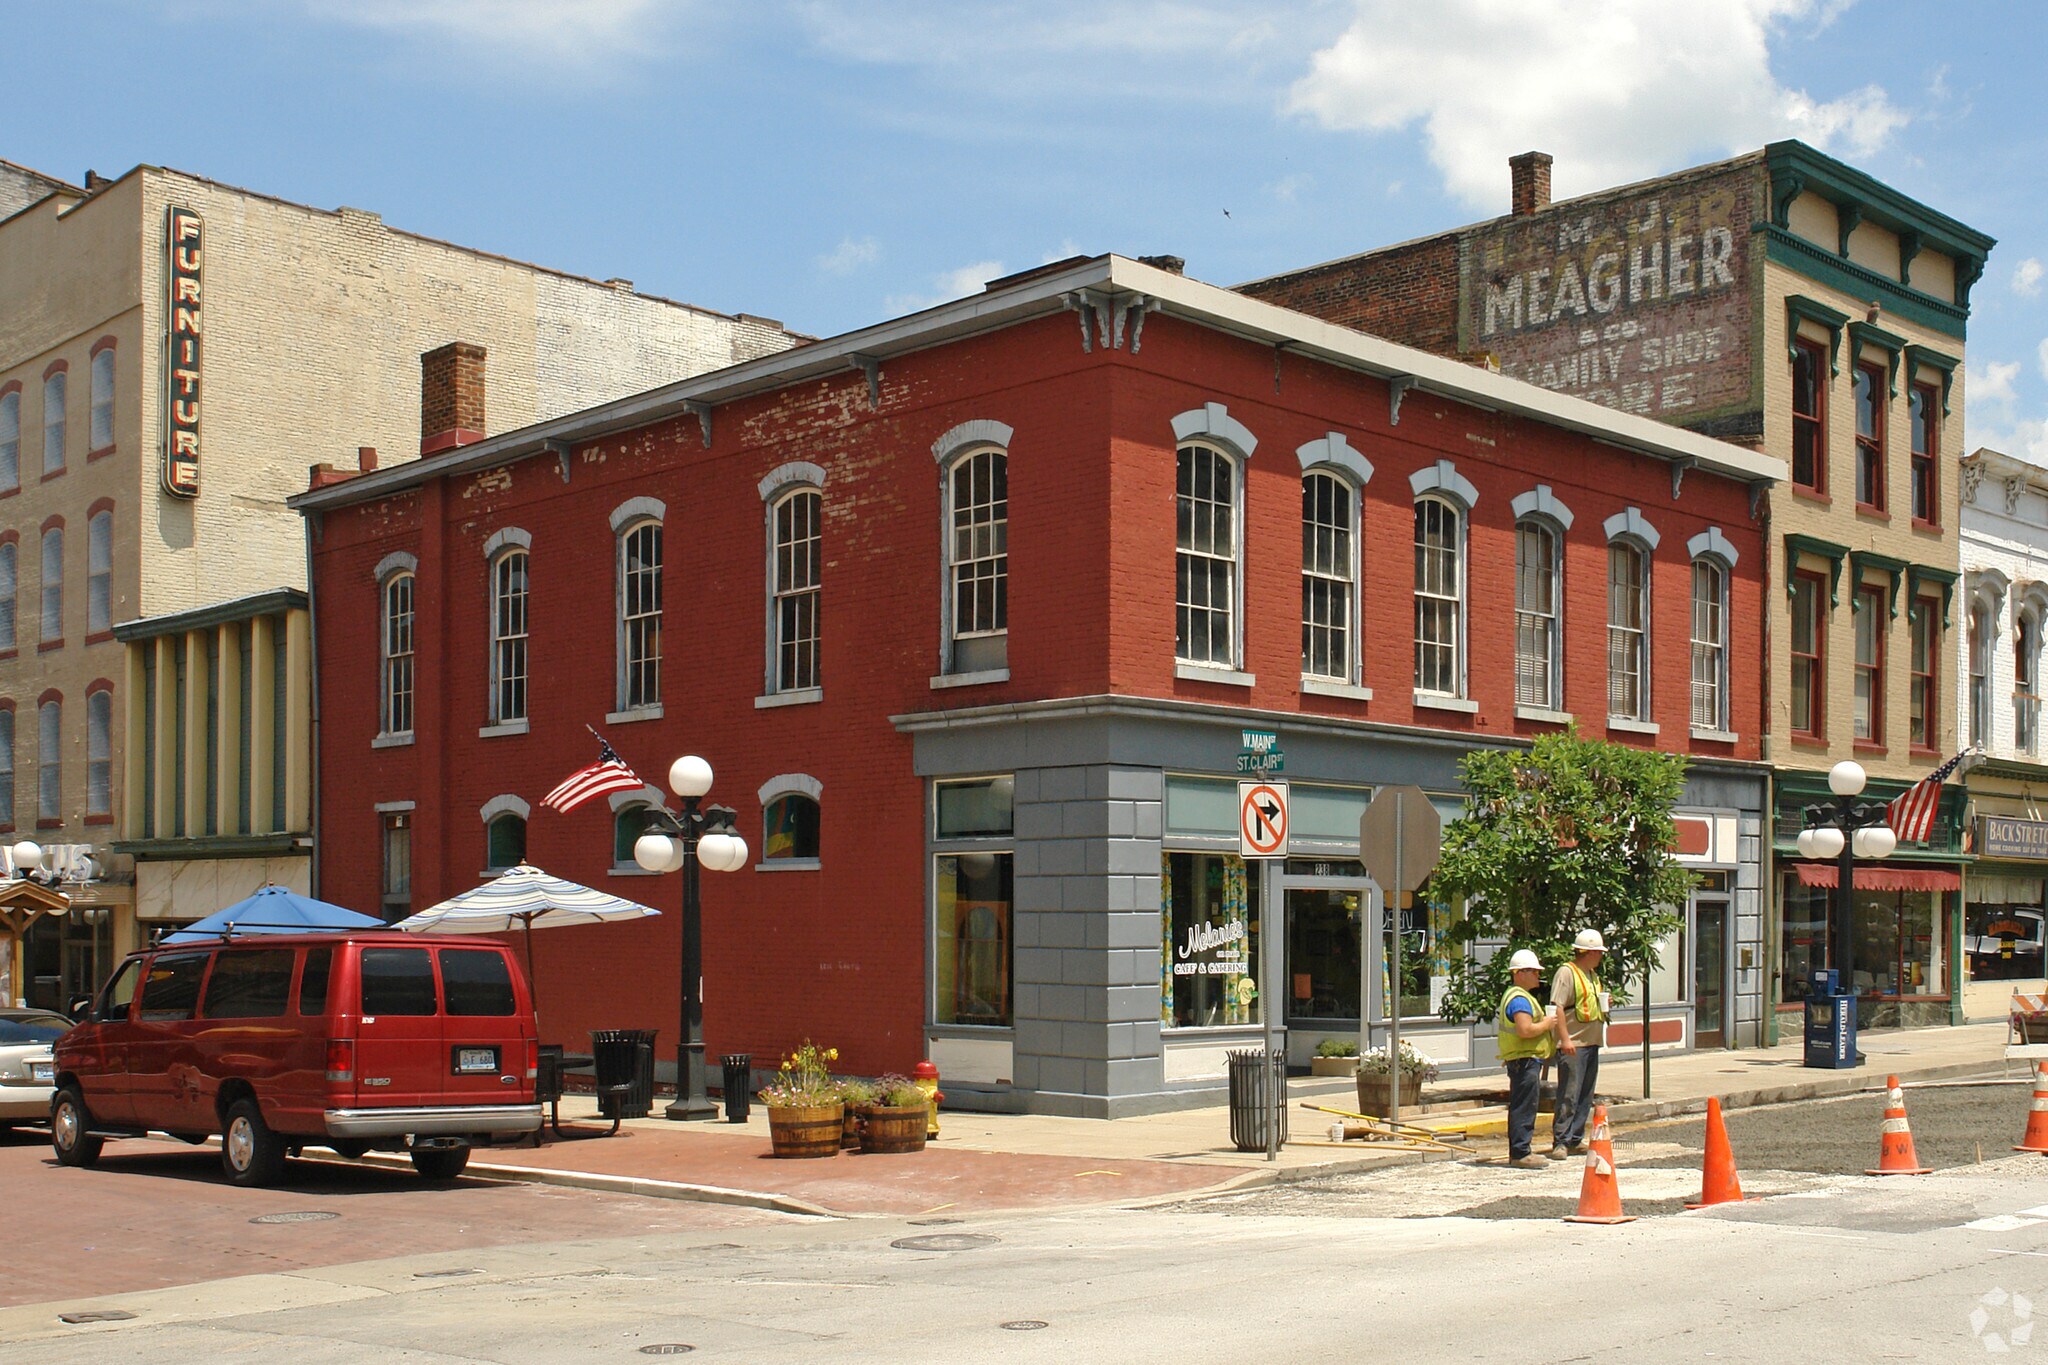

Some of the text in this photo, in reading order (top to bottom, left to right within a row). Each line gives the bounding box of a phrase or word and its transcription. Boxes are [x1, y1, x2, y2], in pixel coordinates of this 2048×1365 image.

[1484, 226, 1736, 336] MEAGHER
[174, 214, 201, 487] FURNITURE
[1315, 863, 1330, 877] 238
[1179, 917, 1244, 959] Melanie's
[1198, 962, 1207, 974] &
[1207, 962, 1248, 974] CATERING
